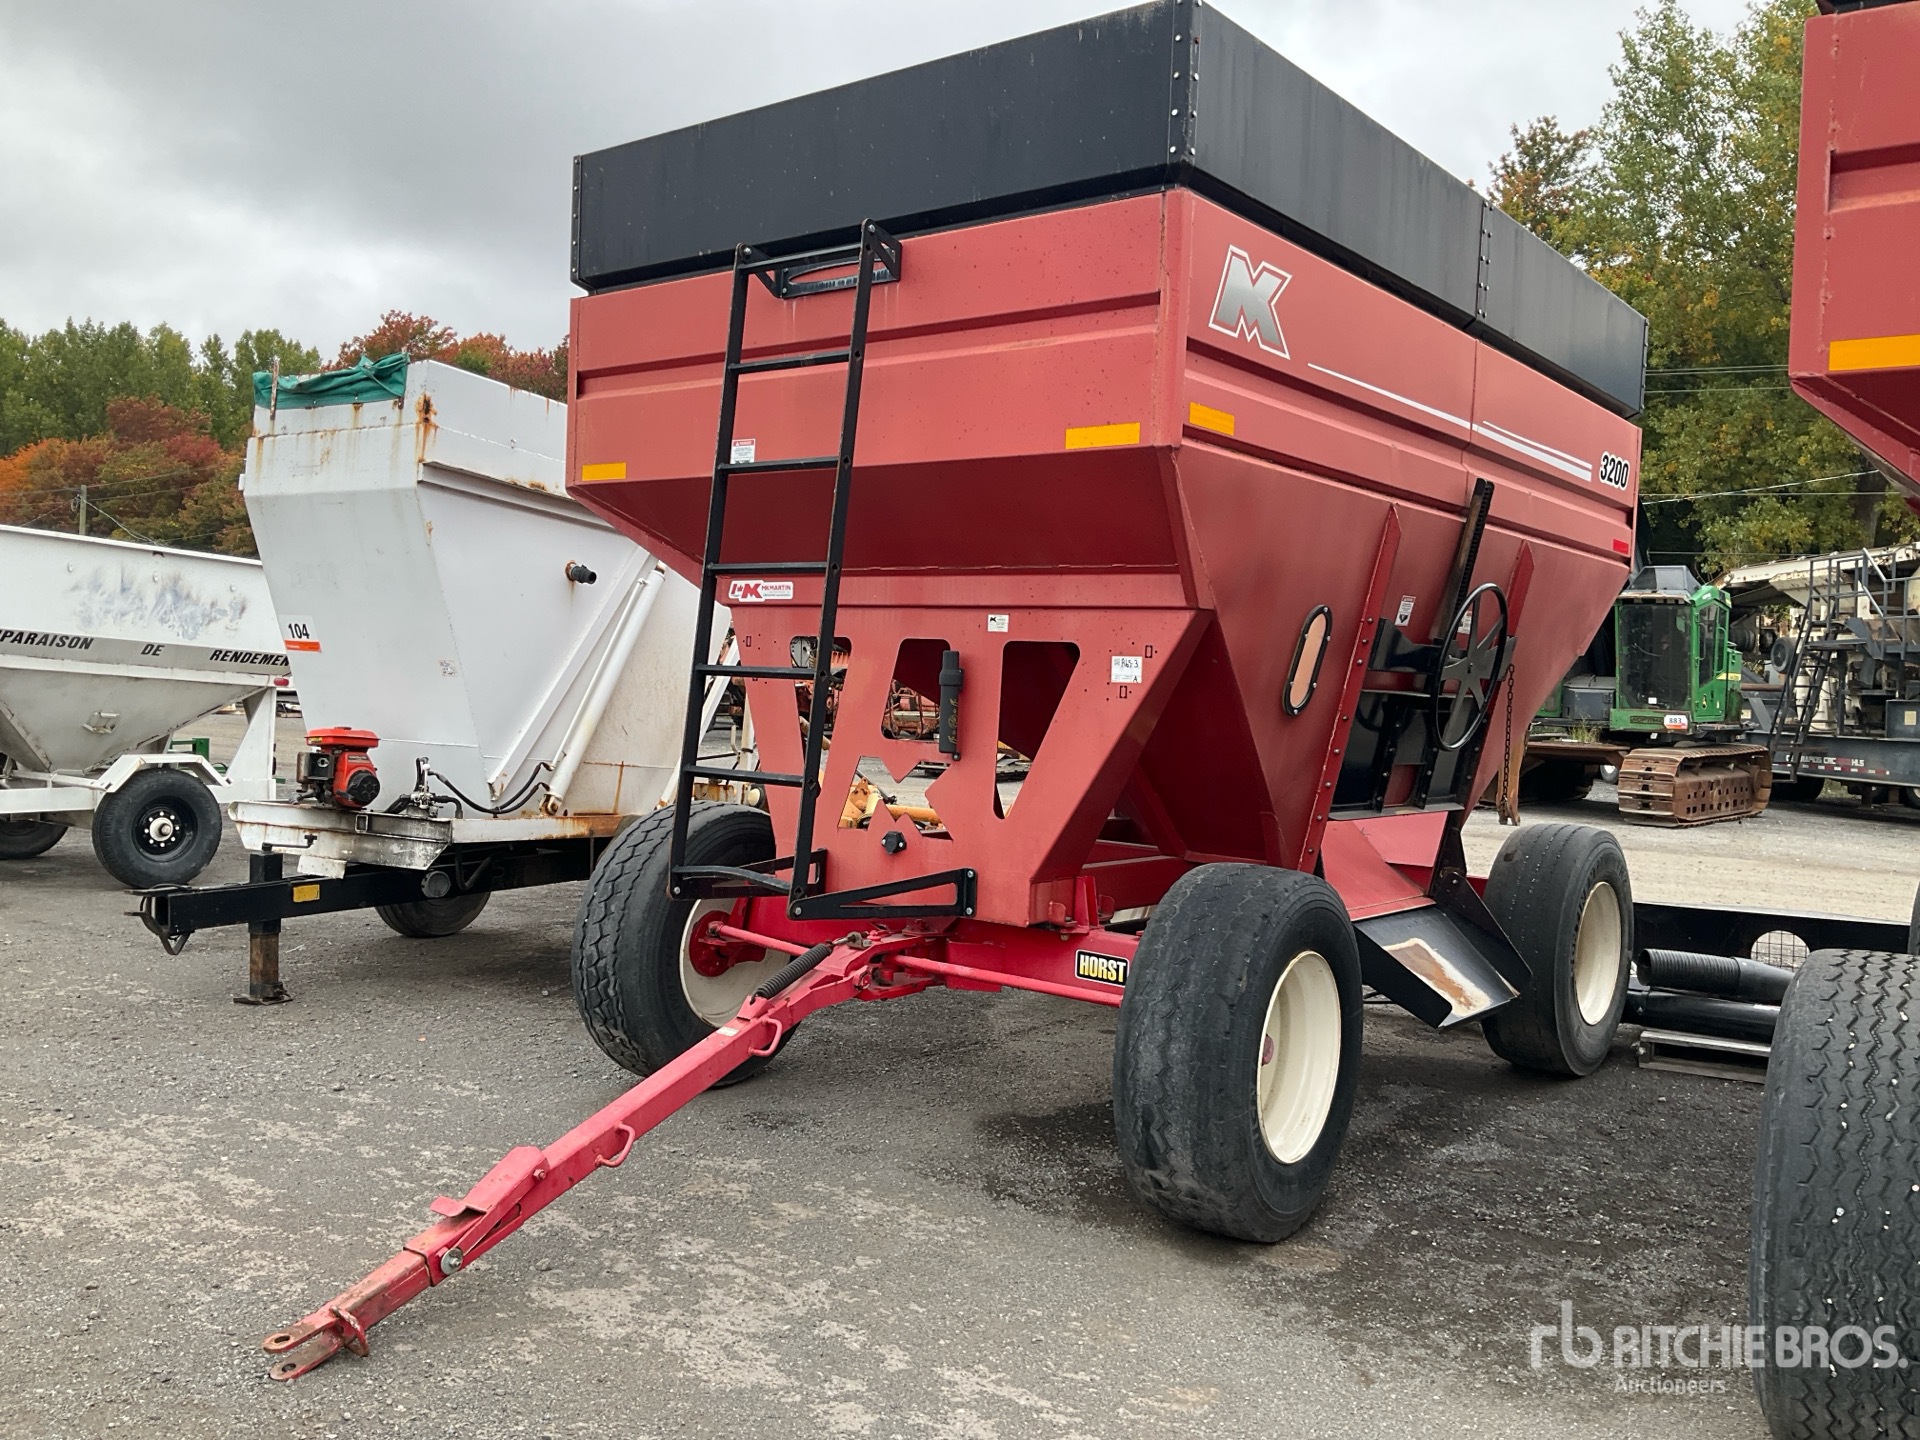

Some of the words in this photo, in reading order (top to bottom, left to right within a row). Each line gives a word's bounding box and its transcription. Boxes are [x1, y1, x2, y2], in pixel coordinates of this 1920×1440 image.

[1600, 453, 1629, 489] 3200
[0, 630, 95, 650] PARAISON
[141, 643, 165, 657] DE
[288, 623, 310, 639] 104
[1080, 954, 1126, 983] HORST
